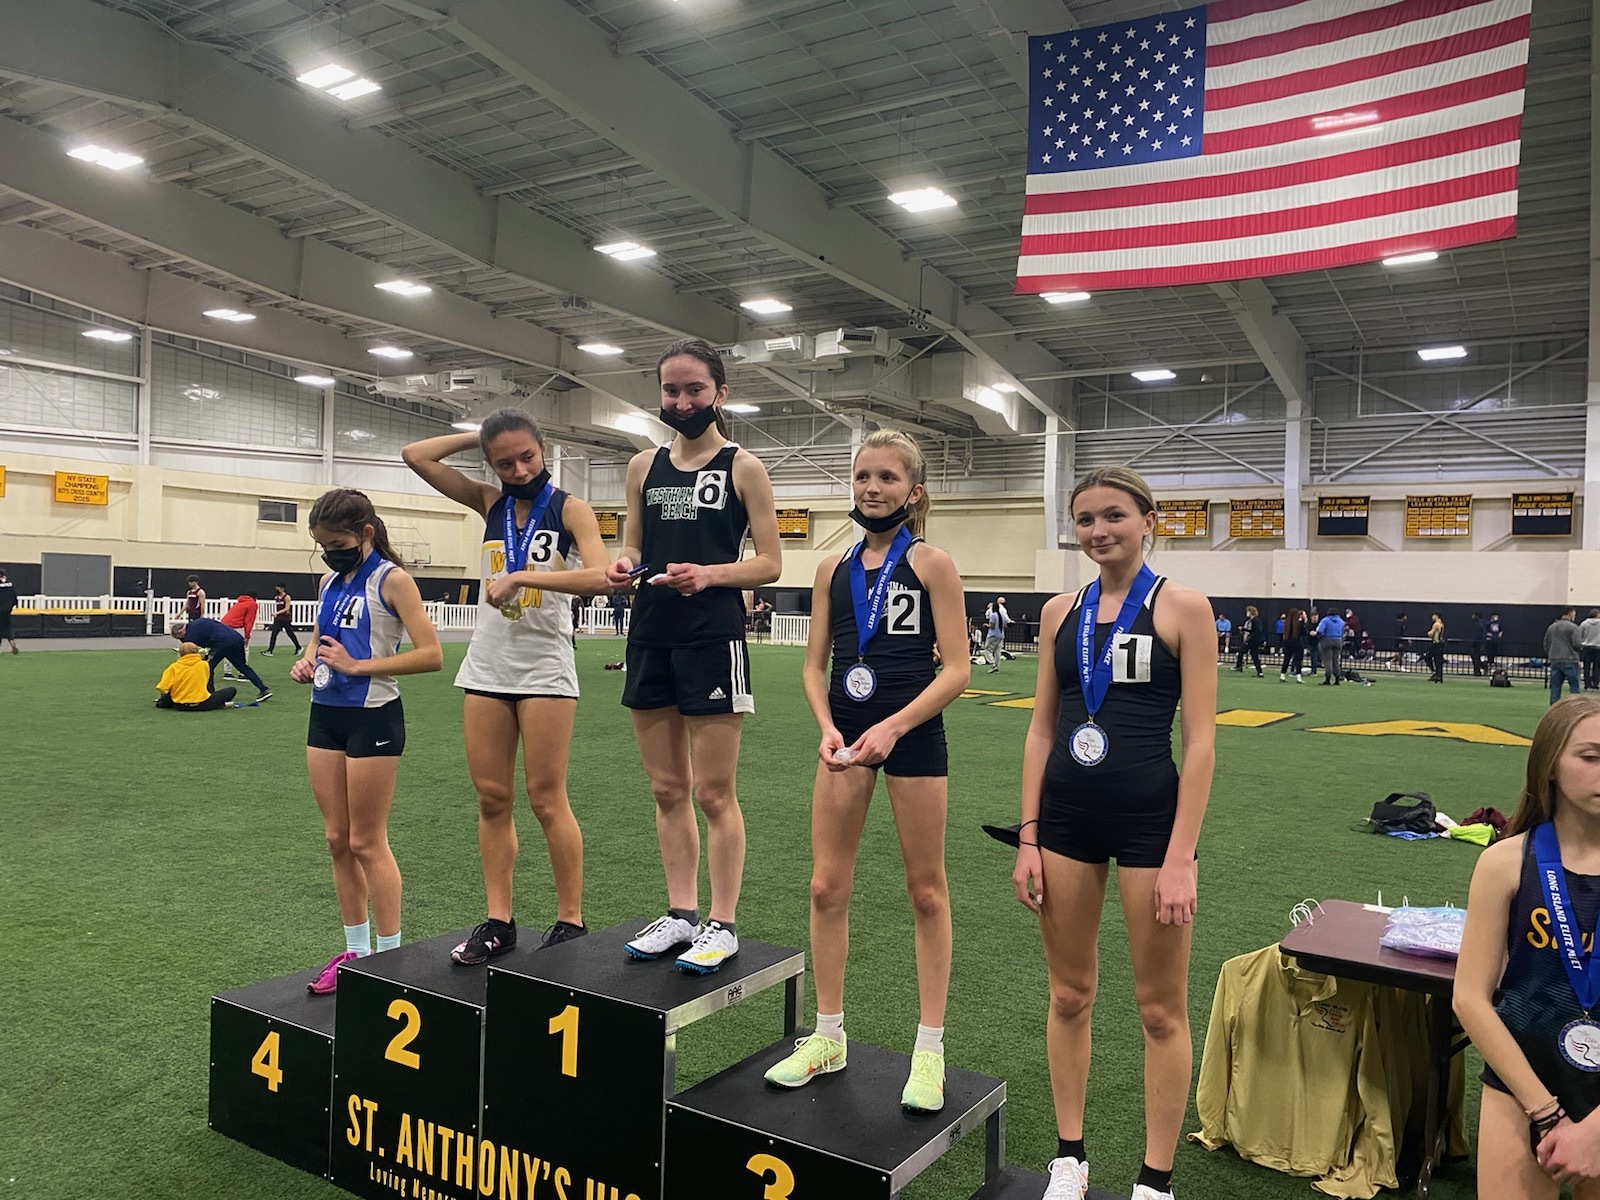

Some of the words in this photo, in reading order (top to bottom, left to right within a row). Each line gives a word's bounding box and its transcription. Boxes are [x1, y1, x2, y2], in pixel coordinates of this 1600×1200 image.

[64, 481, 99, 490] CHAMPIONS
[698, 472, 721, 505] 6
[520, 536, 529, 551] PLACE
[531, 532, 552, 563] 3
[876, 574, 887, 595] ISLAND
[342, 597, 358, 626] 4
[871, 595, 881, 613] ELITE
[892, 594, 915, 631] 2
[1084, 609, 1093, 625] LONG
[867, 612, 876, 630] MEET
[1082, 625, 1090, 647] ISLAND
[1119, 637, 1138, 679] 1
[1546, 869, 1559, 891] LONG
[1551, 892, 1567, 923] ISLAND
[1560, 923, 1574, 948] ELITE
[383, 998, 423, 1070] 2
[548, 1004, 580, 1078] 1
[251, 1030, 283, 1093] 4
[346, 1094, 385, 1157] ST.
[369, 1161, 407, 1198] Loving
[745, 1153, 796, 1200] 3
